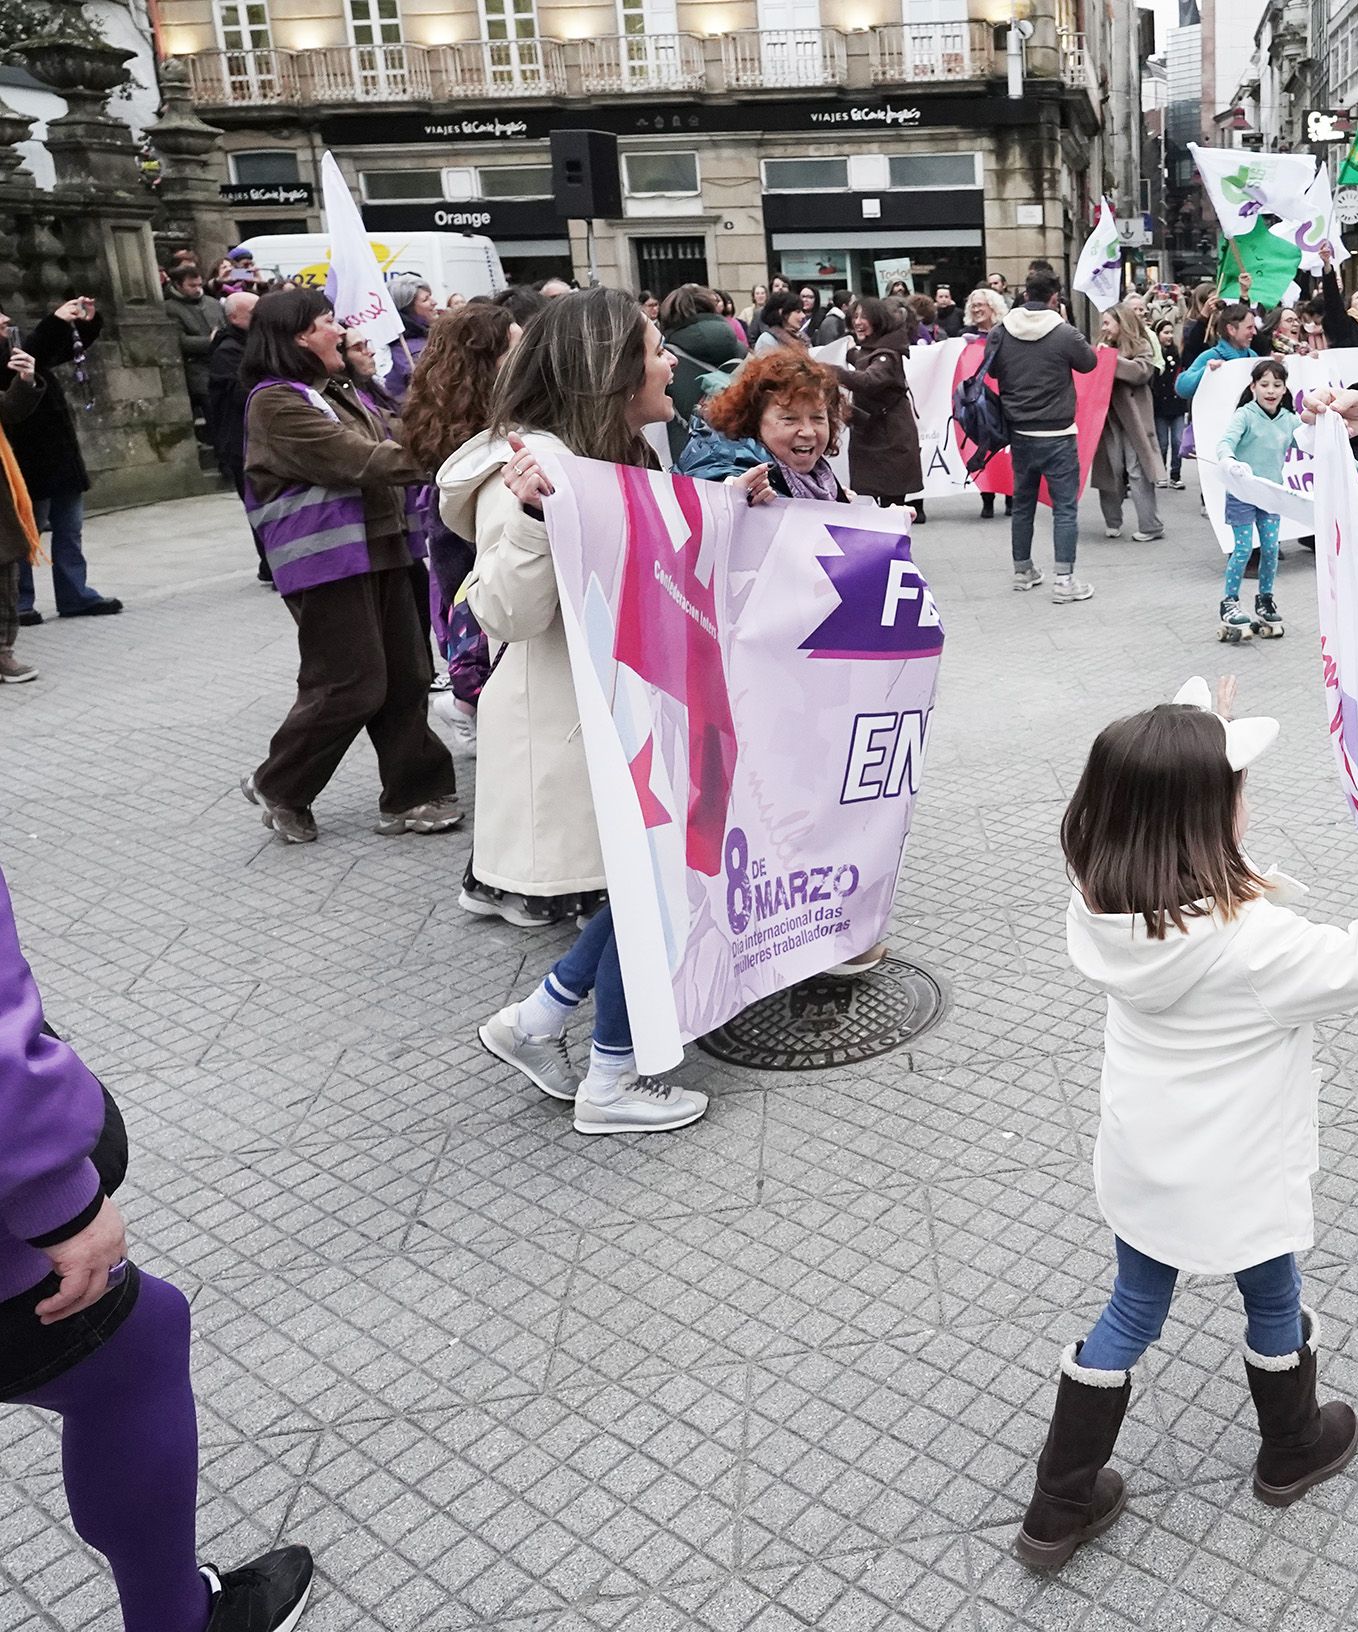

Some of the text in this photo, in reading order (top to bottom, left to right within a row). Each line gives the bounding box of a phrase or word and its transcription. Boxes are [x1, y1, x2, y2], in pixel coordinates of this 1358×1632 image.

[424, 125, 461, 136] VIAJES
[811, 112, 849, 123] VIAJES
[434, 210, 491, 228] Orange
[725, 827, 752, 935] 8
[752, 858, 767, 880] DE
[755, 864, 860, 922] MARZO
[744, 909, 812, 949] internacional
[815, 906, 843, 922] das
[733, 918, 851, 978] mulleres traballadoras
